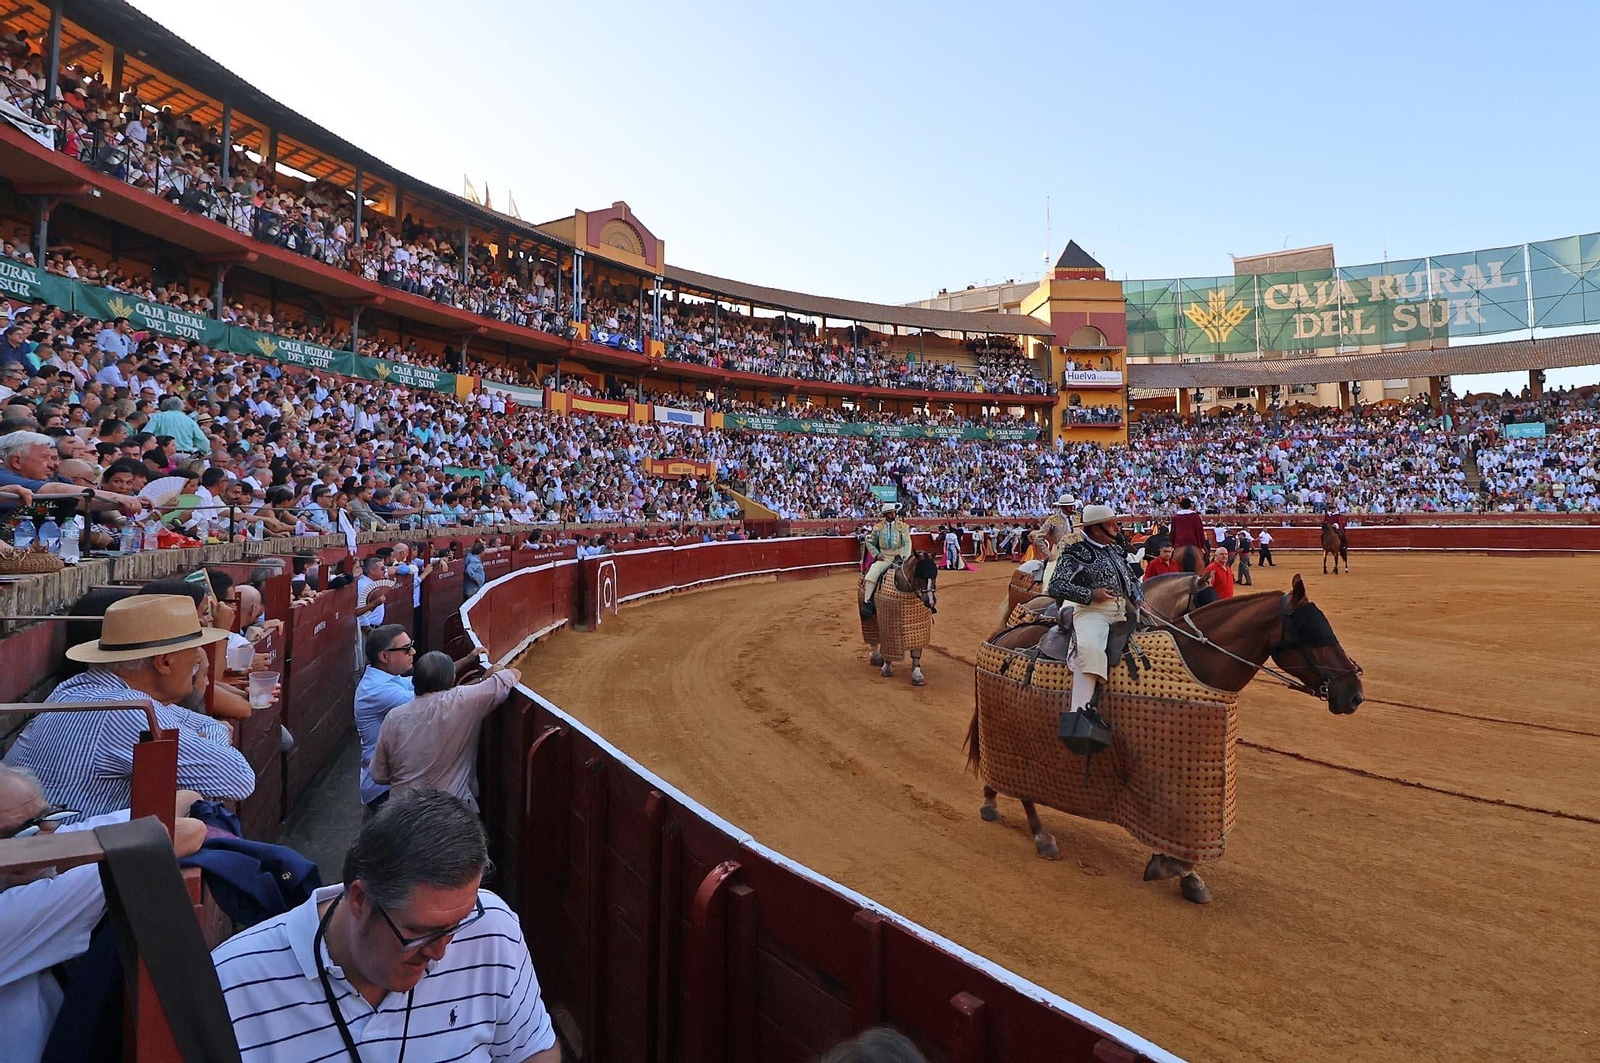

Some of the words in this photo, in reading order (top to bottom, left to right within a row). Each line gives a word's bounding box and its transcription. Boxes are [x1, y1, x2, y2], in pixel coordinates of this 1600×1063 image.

[0, 262, 41, 285] URAL
[1264, 279, 1358, 310] CAJA
[1367, 261, 1518, 302] RURAL
[135, 303, 165, 320] CAJA
[167, 311, 206, 330] RURAL
[1292, 309, 1376, 339] DEL
[1392, 298, 1486, 332] SUR
[144, 317, 171, 333] DEL
[175, 325, 200, 340] SUR
[278, 340, 302, 354] CAJA
[304, 345, 335, 360] RURAL
[287, 351, 306, 364] DEL
[309, 357, 329, 369] SUR
[392, 365, 412, 376] CAJA
[414, 369, 440, 381] RURAL
[398, 375, 416, 386] DEL
[418, 379, 435, 389] SUR
[1067, 372, 1097, 380] Huelva
